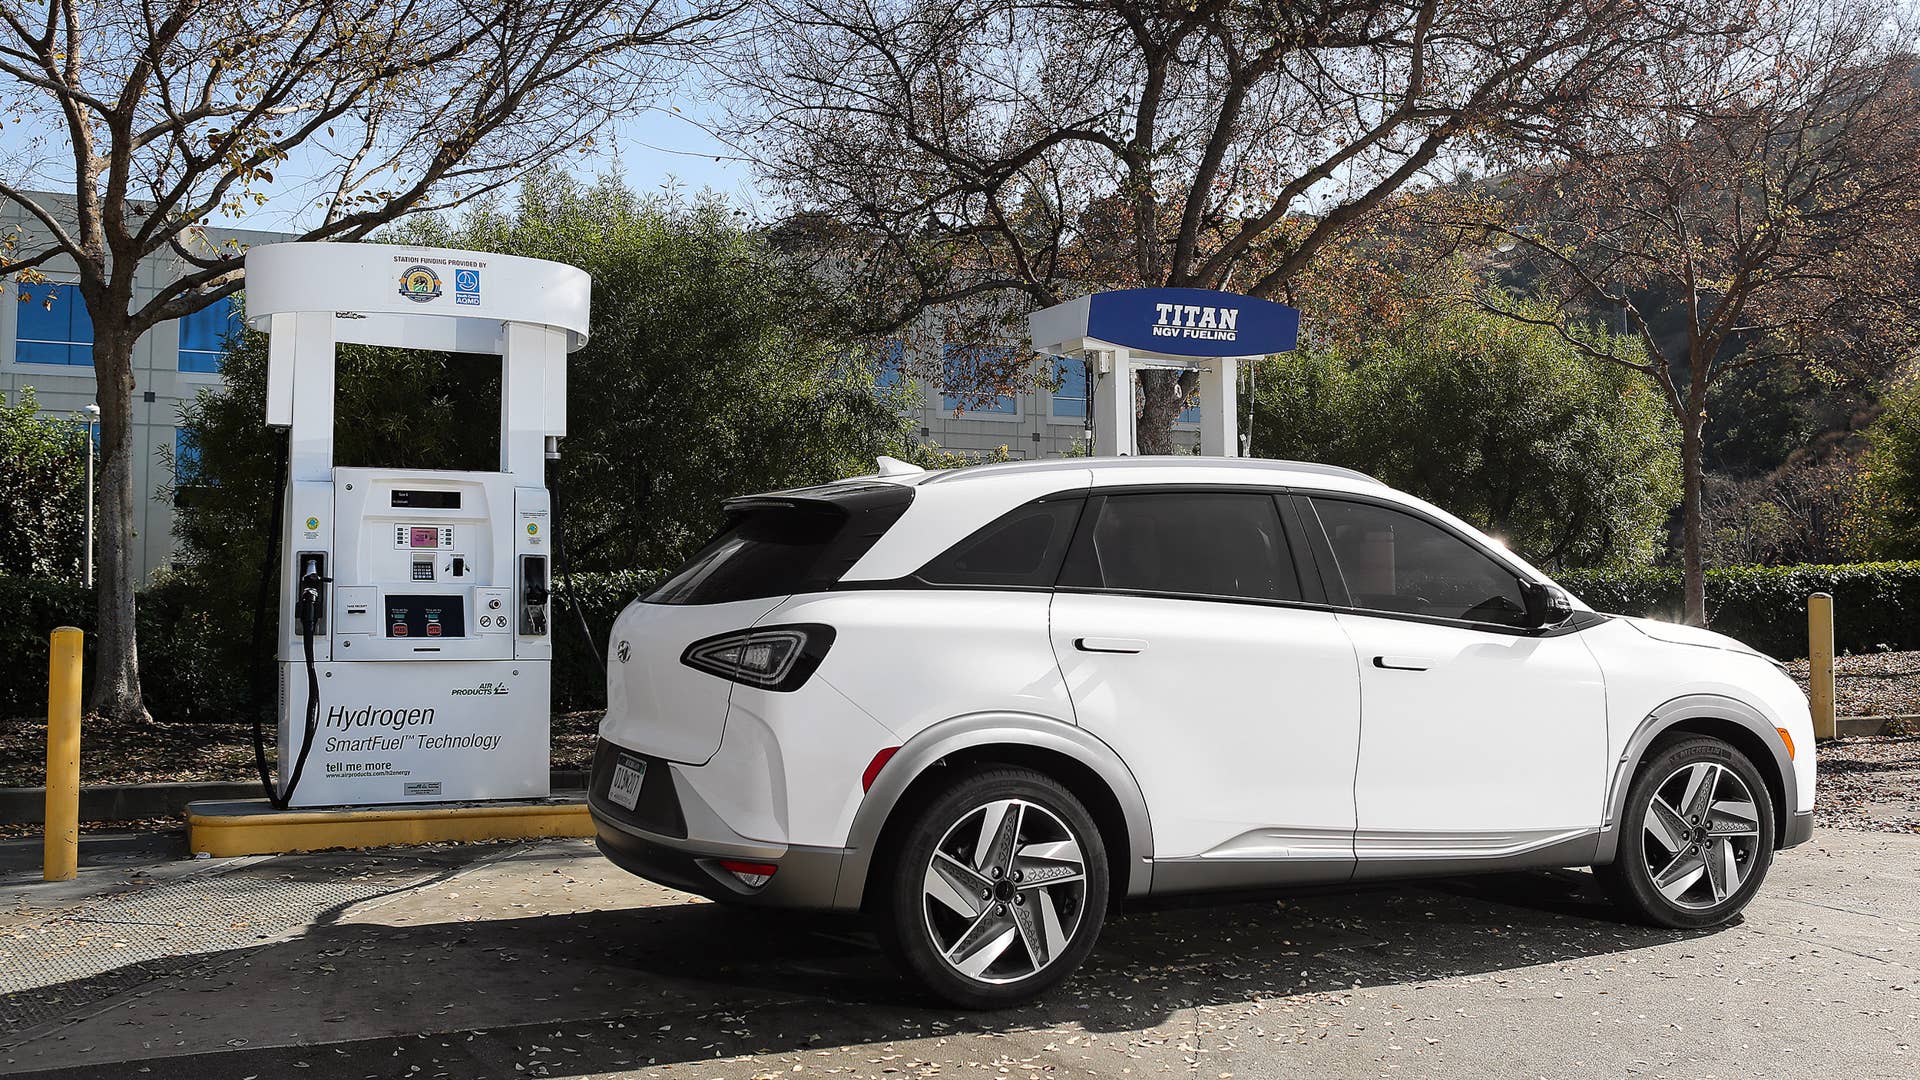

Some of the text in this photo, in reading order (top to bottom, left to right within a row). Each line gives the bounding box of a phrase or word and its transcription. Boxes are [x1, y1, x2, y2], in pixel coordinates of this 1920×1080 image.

[393, 256, 419, 264] STATION
[448, 259, 478, 267] PROVIDED
[1156, 303, 1239, 330] TITAN
[1152, 326, 1236, 341] NGV FUELING
[326, 705, 435, 732] Hydrogen
[418, 733, 502, 750] Technology
[326, 762, 392, 772] tell me more
